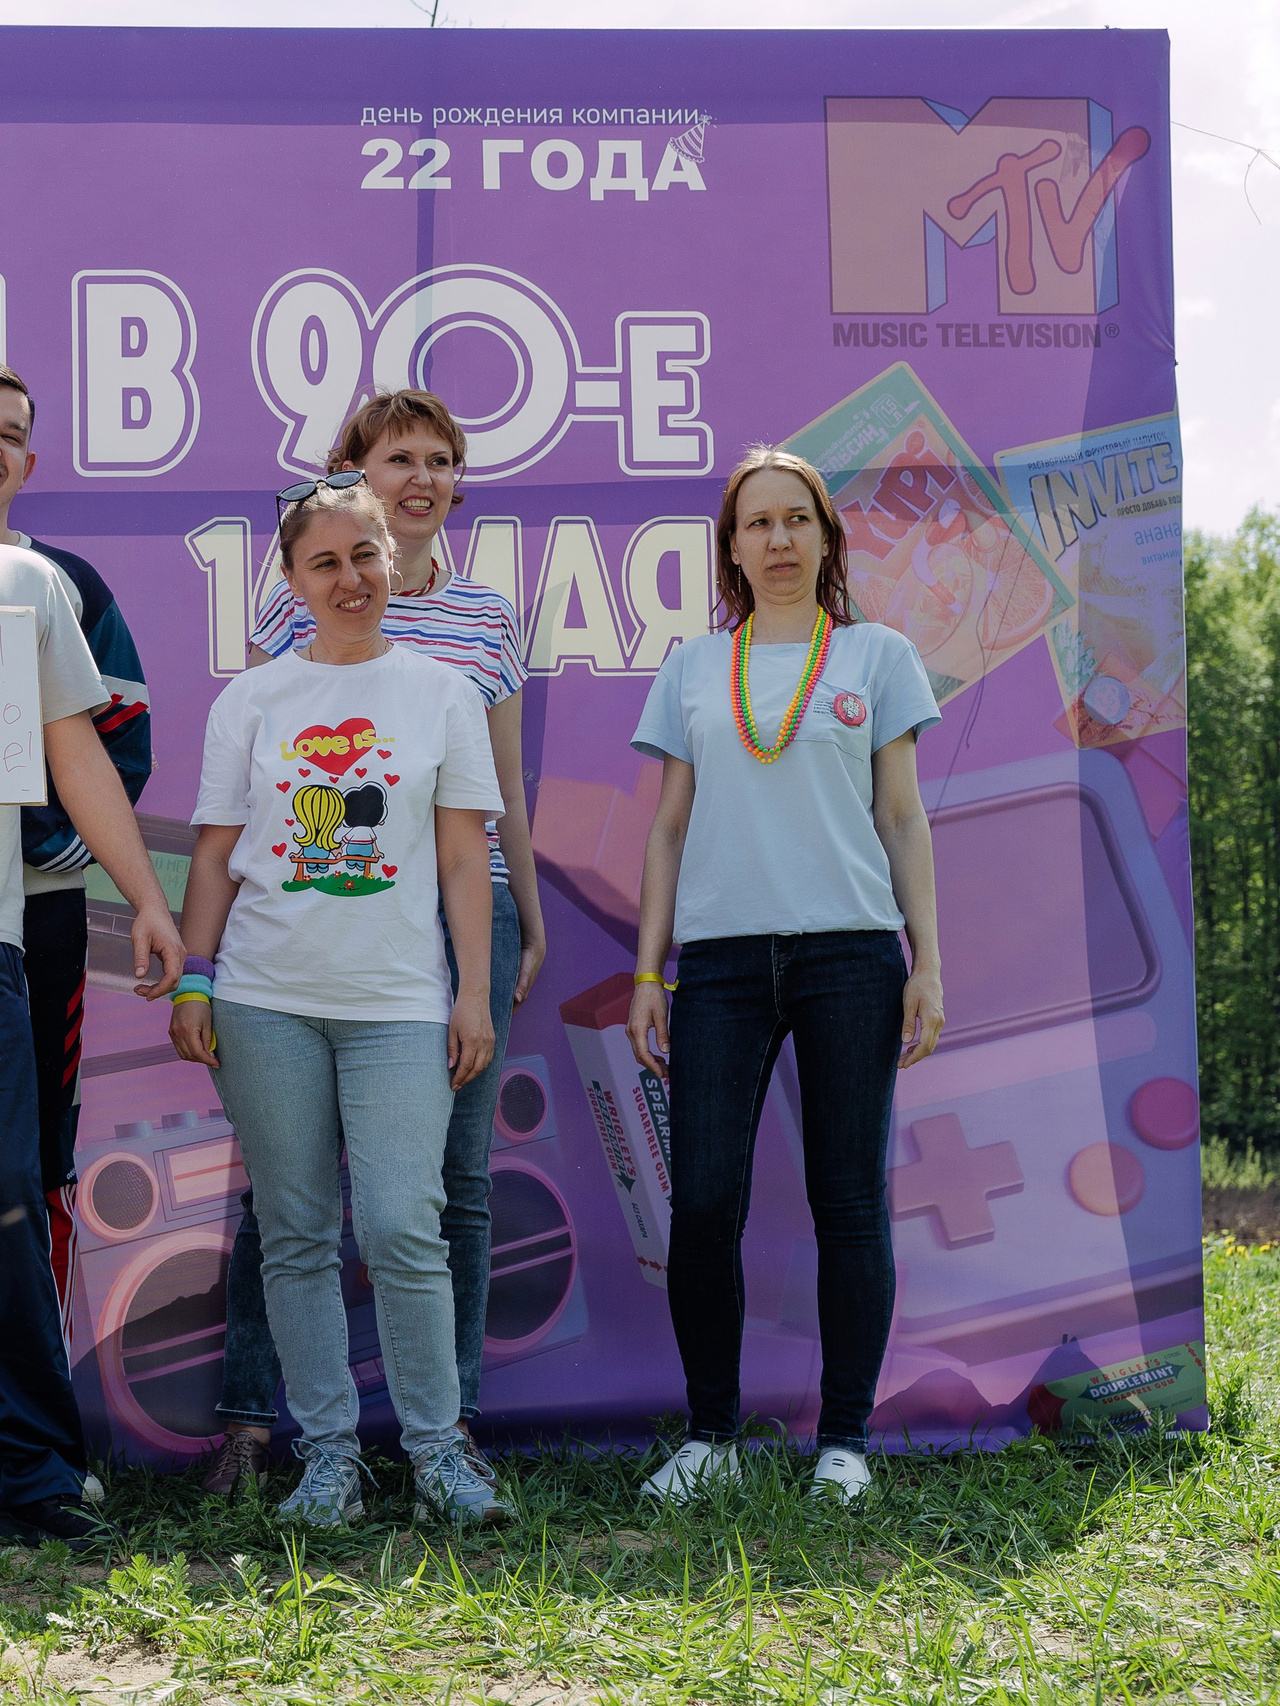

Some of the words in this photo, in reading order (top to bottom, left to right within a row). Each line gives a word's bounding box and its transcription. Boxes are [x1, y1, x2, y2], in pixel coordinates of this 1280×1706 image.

[360, 107, 423, 126] день
[433, 107, 563, 128] рождения
[573, 107, 699, 125] компании
[360, 138, 452, 190] 22
[482, 139, 707, 201] ГОДА
[824, 95, 1151, 315] MTV
[832, 322, 928, 348] MUSIC
[71, 269, 202, 478] В
[819, 423, 881, 480] ЕЛЬСИН
[1028, 451, 1084, 471] РАСТВОРИМЫЙ
[1085, 438, 1131, 457] ФРУКТОВЫЙ
[1133, 431, 1168, 446] НАПИТОК
[1029, 441, 1179, 562] INVITE
[1116, 504, 1141, 516] ПРОСТО
[1142, 499, 1168, 512] ДОБАВЬ
[1134, 522, 1181, 546] анана
[587, 1086, 610, 1144] SUGARFREE
[605, 1146, 619, 1171] GUM
[603, 1090, 637, 1177] WRIGLEY'S
[632, 1086, 660, 1159] SUGARFREE
[655, 1161, 670, 1193] GUM
[645, 1078, 671, 1162] SPEARM
[1090, 1358, 1162, 1385] WRIGLEY'S
[1090, 1365, 1175, 1398] DOUBLEMINT
[1101, 1386, 1153, 1405] SUGARFREE
[1154, 1378, 1176, 1390] GUM
